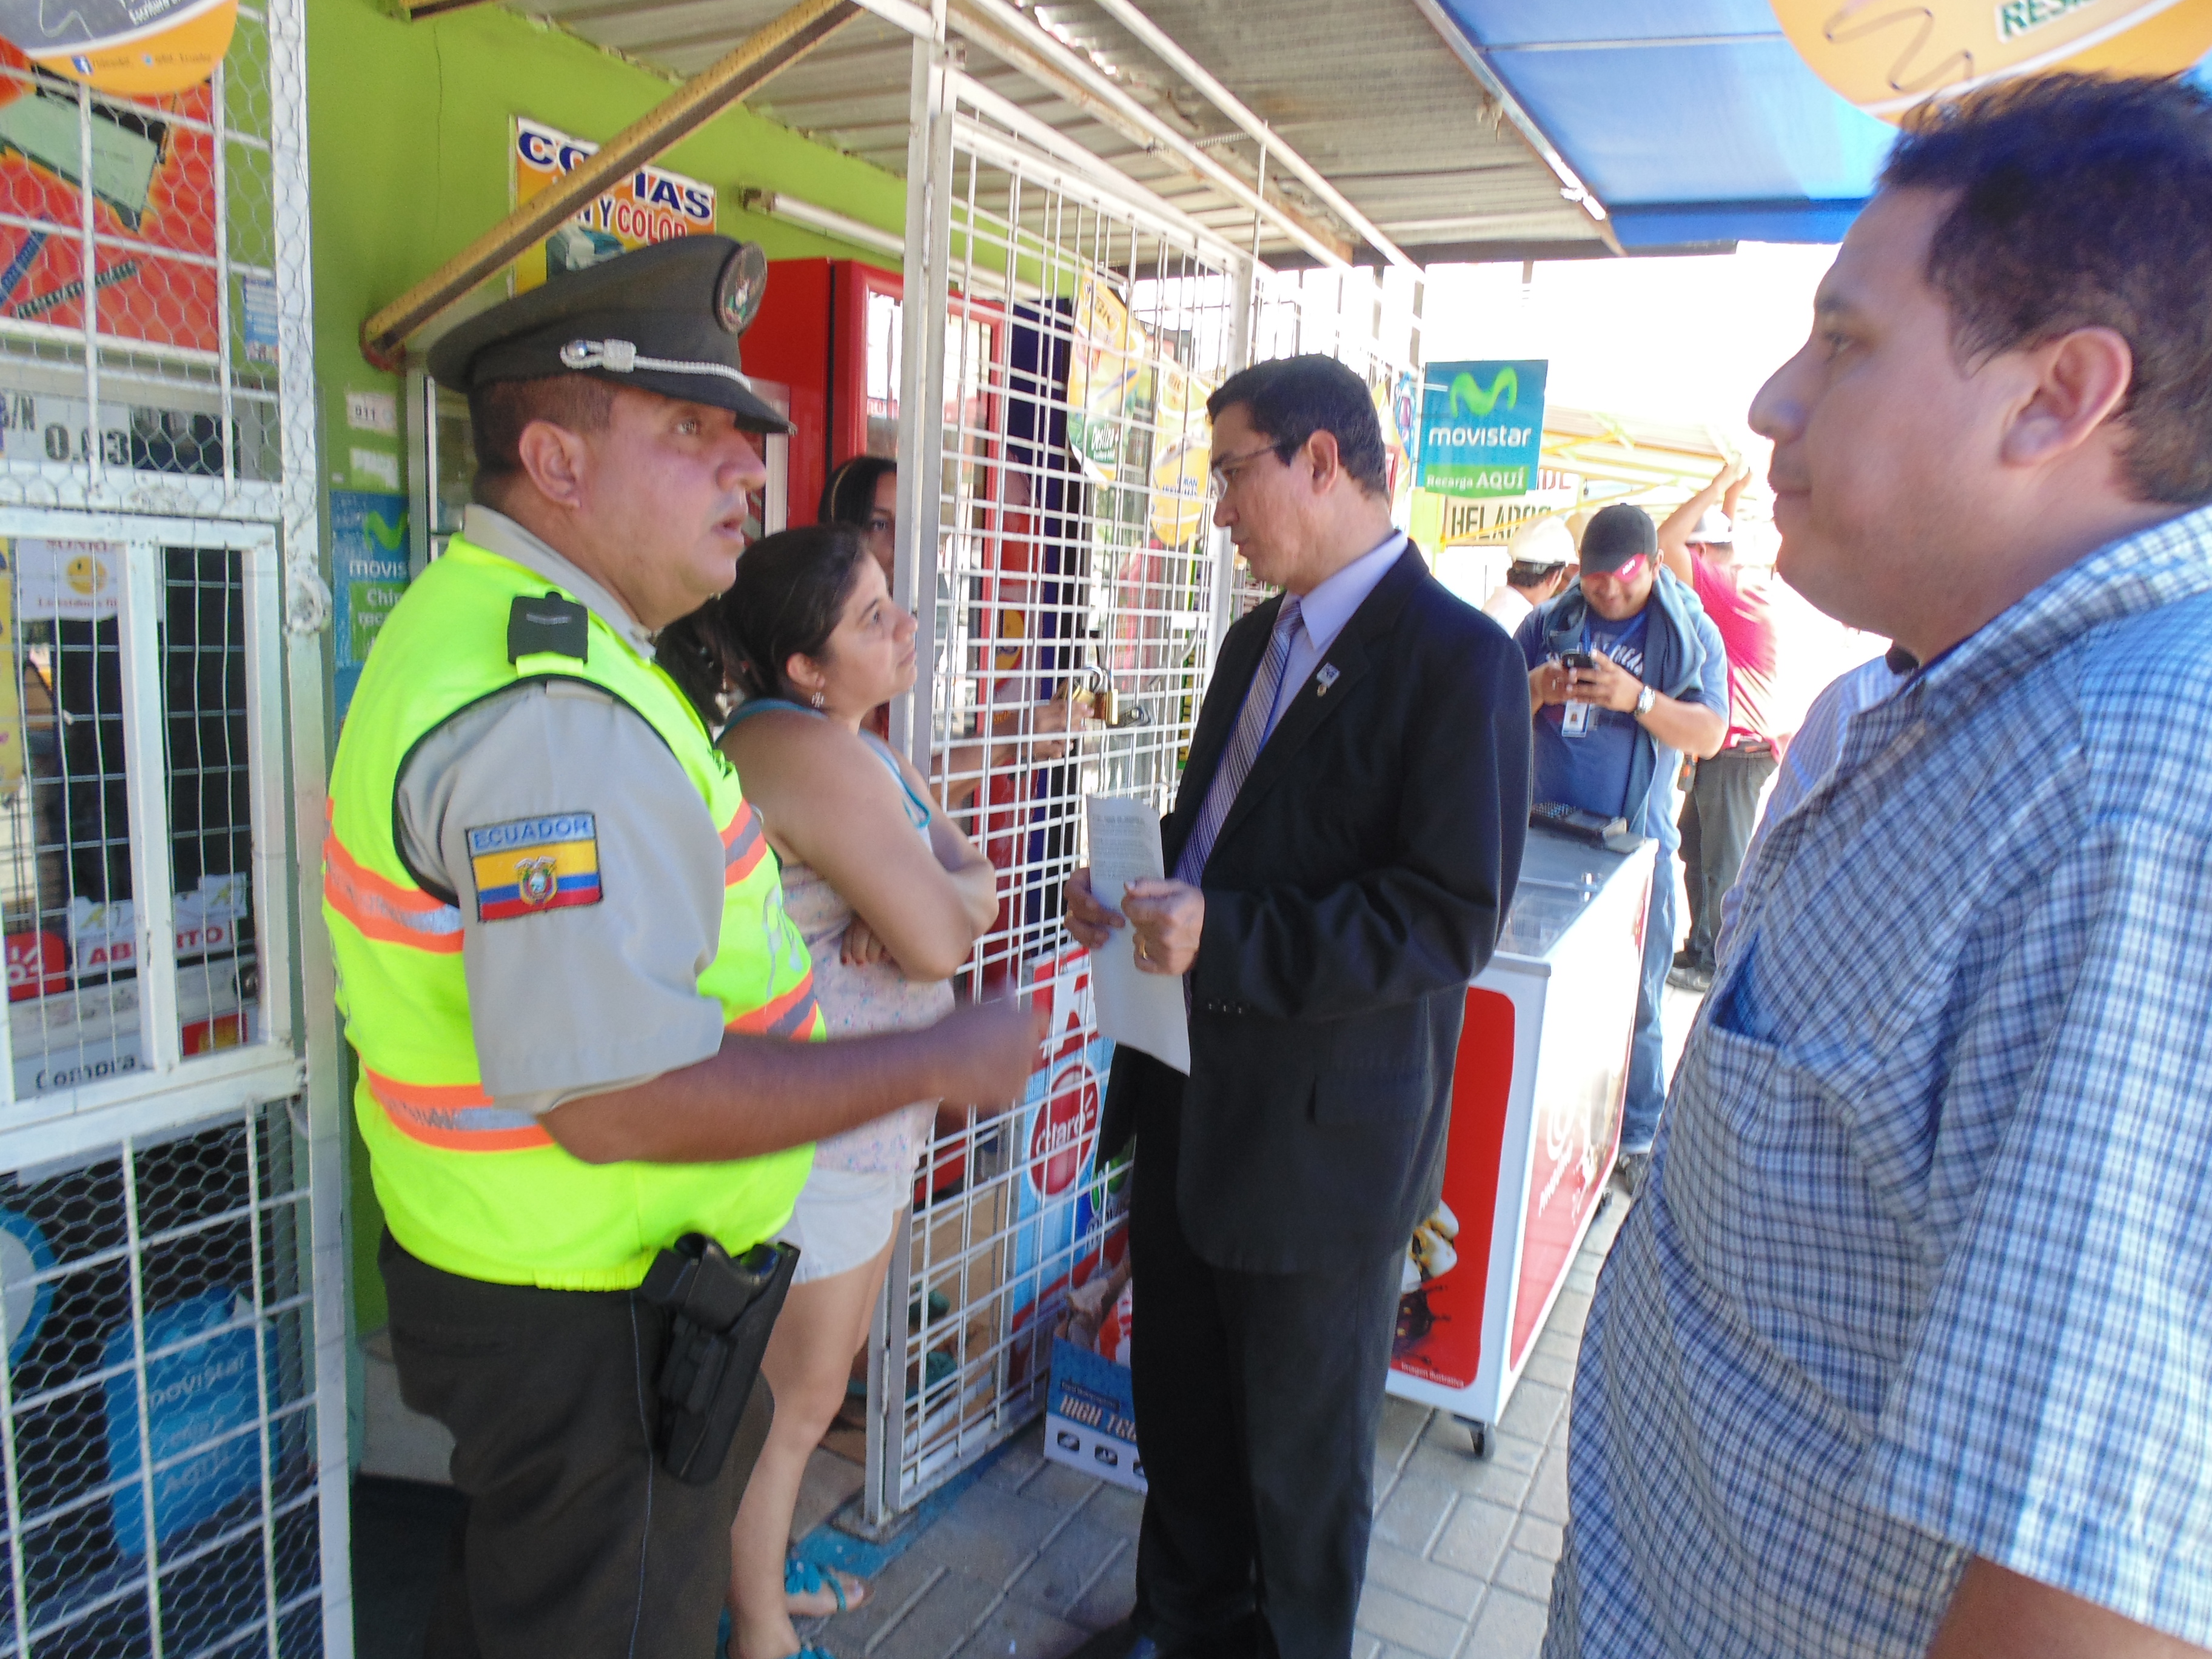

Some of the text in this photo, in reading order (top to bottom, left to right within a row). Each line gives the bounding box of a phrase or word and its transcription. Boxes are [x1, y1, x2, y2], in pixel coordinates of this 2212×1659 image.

[518, 130, 711, 220] COIAS
[1429, 425, 1532, 447] movistar
[1427, 474, 1473, 491] Recarga
[1476, 466, 1524, 491] AQUÍ
[349, 560, 407, 577] movis
[474, 817, 589, 851] ECUADOR
[89, 925, 224, 966] ABTO
